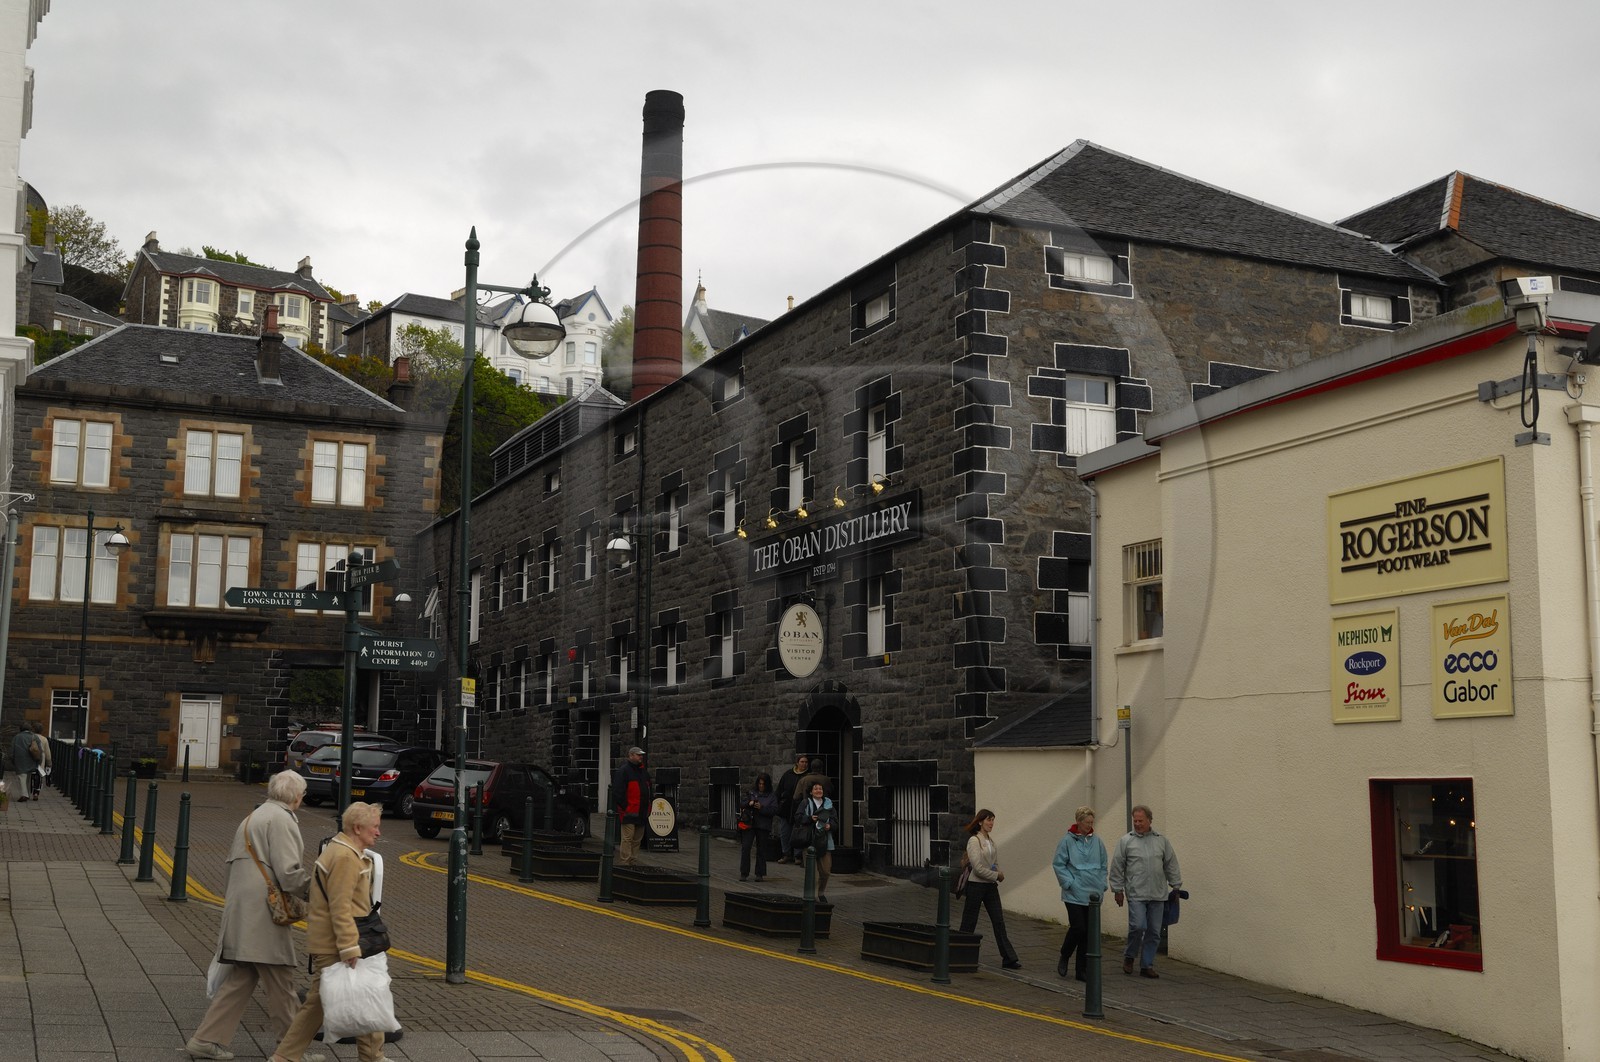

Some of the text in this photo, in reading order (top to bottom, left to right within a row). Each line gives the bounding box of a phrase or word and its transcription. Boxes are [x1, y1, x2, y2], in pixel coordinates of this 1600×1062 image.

[1395, 497, 1427, 519] FINE
[753, 501, 912, 572] THE OBAN DISTILLERY
[1340, 505, 1490, 562] ROGERSON
[1376, 550, 1450, 574] FOOTWEAR
[243, 590, 268, 598] TOWN
[273, 591, 306, 599] CENTRE
[243, 597, 292, 606] LONGSDALE
[783, 630, 819, 639] OBAN
[1443, 609, 1499, 640] Van Dal
[373, 640, 404, 648] TOURIST
[1337, 627, 1379, 647] MEPHISTO
[371, 658, 400, 666] CENTRE
[372, 649, 423, 657] INFORMATION
[1443, 650, 1498, 674] ecco
[1348, 658, 1381, 671] Rockport
[1344, 682, 1387, 704] Sioux
[1443, 679, 1498, 703] Gabor
